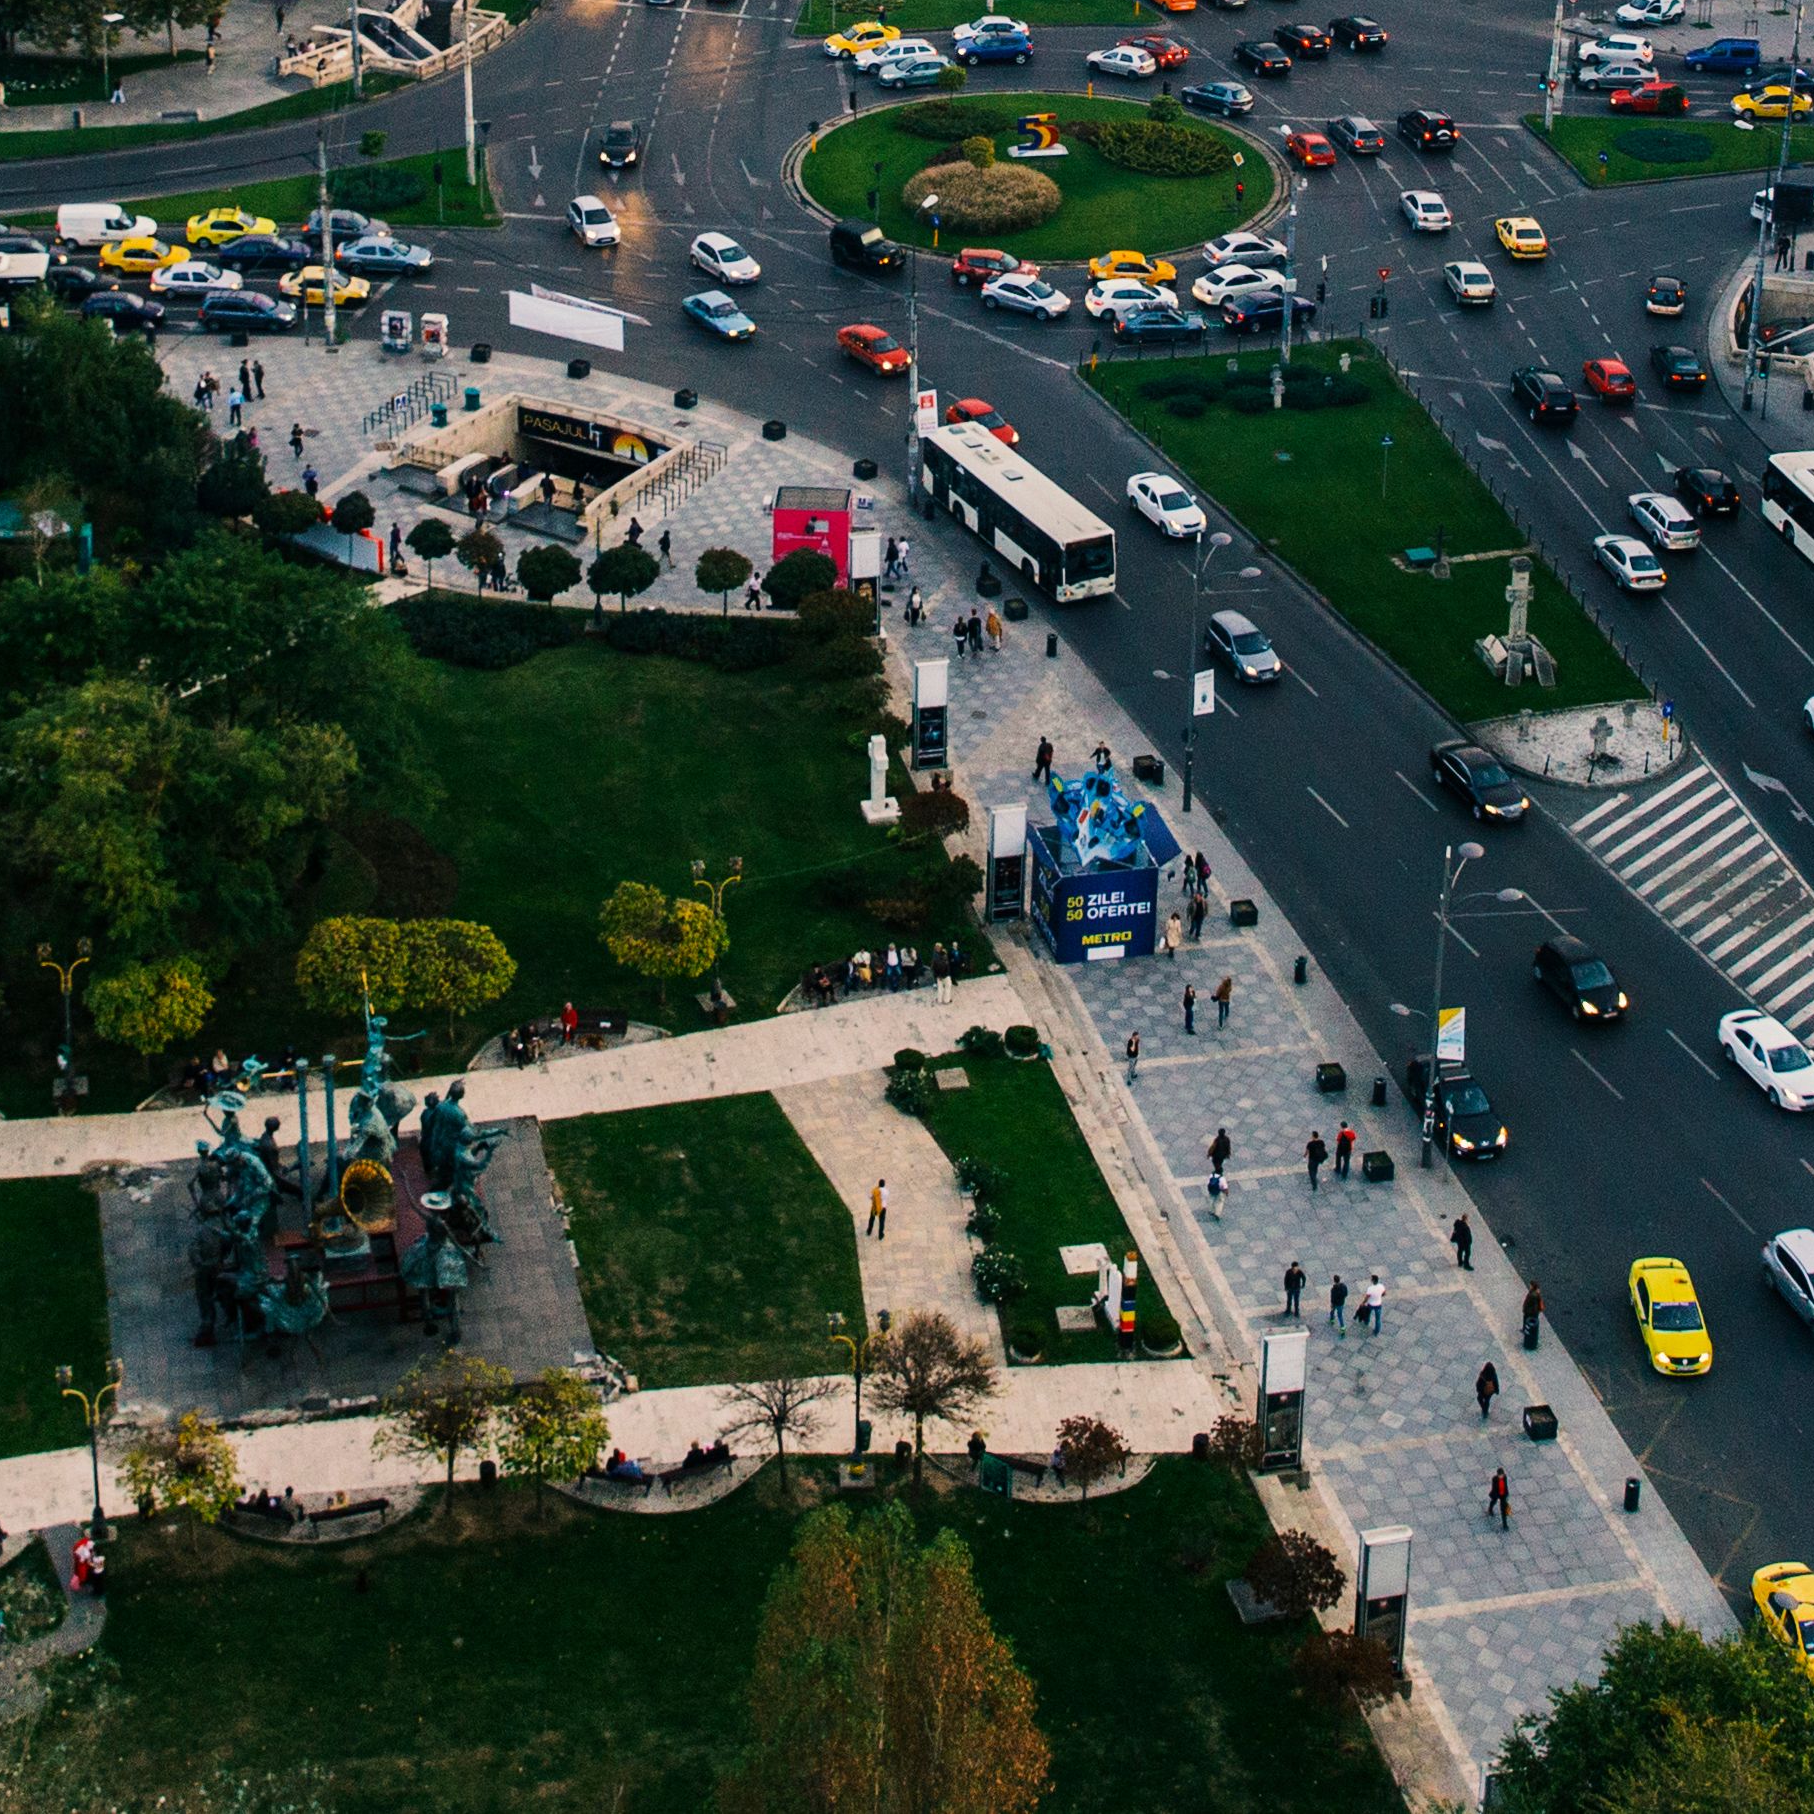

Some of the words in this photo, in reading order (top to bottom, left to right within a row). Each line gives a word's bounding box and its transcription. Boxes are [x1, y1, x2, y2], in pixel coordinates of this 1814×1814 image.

[523, 415, 586, 440] PASAJUL
[1067, 896, 1084, 908] 50
[1088, 891, 1125, 906] ZILE!
[1066, 909, 1083, 921] 50
[1087, 902, 1151, 920] OFERTE!
[1082, 931, 1132, 945] METRO
